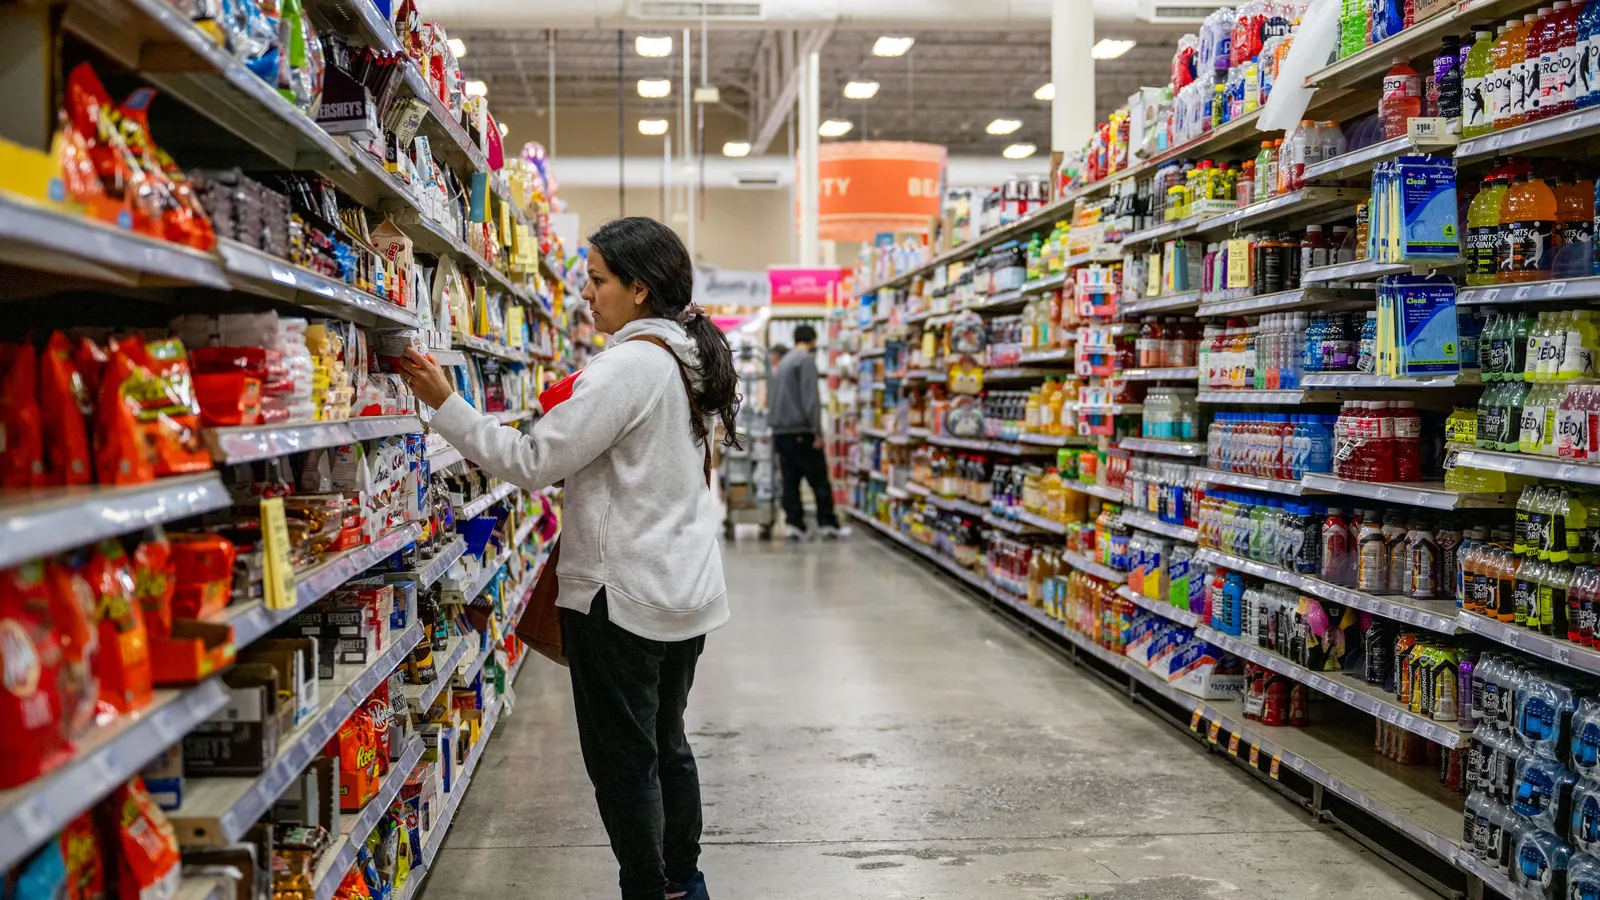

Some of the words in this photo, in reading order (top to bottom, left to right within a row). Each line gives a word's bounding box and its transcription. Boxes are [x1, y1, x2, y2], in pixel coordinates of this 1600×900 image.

[1384, 81, 1401, 90] ERO
[320, 101, 363, 119] ERSHEY'S
[1521, 416, 1536, 430] ZEO
